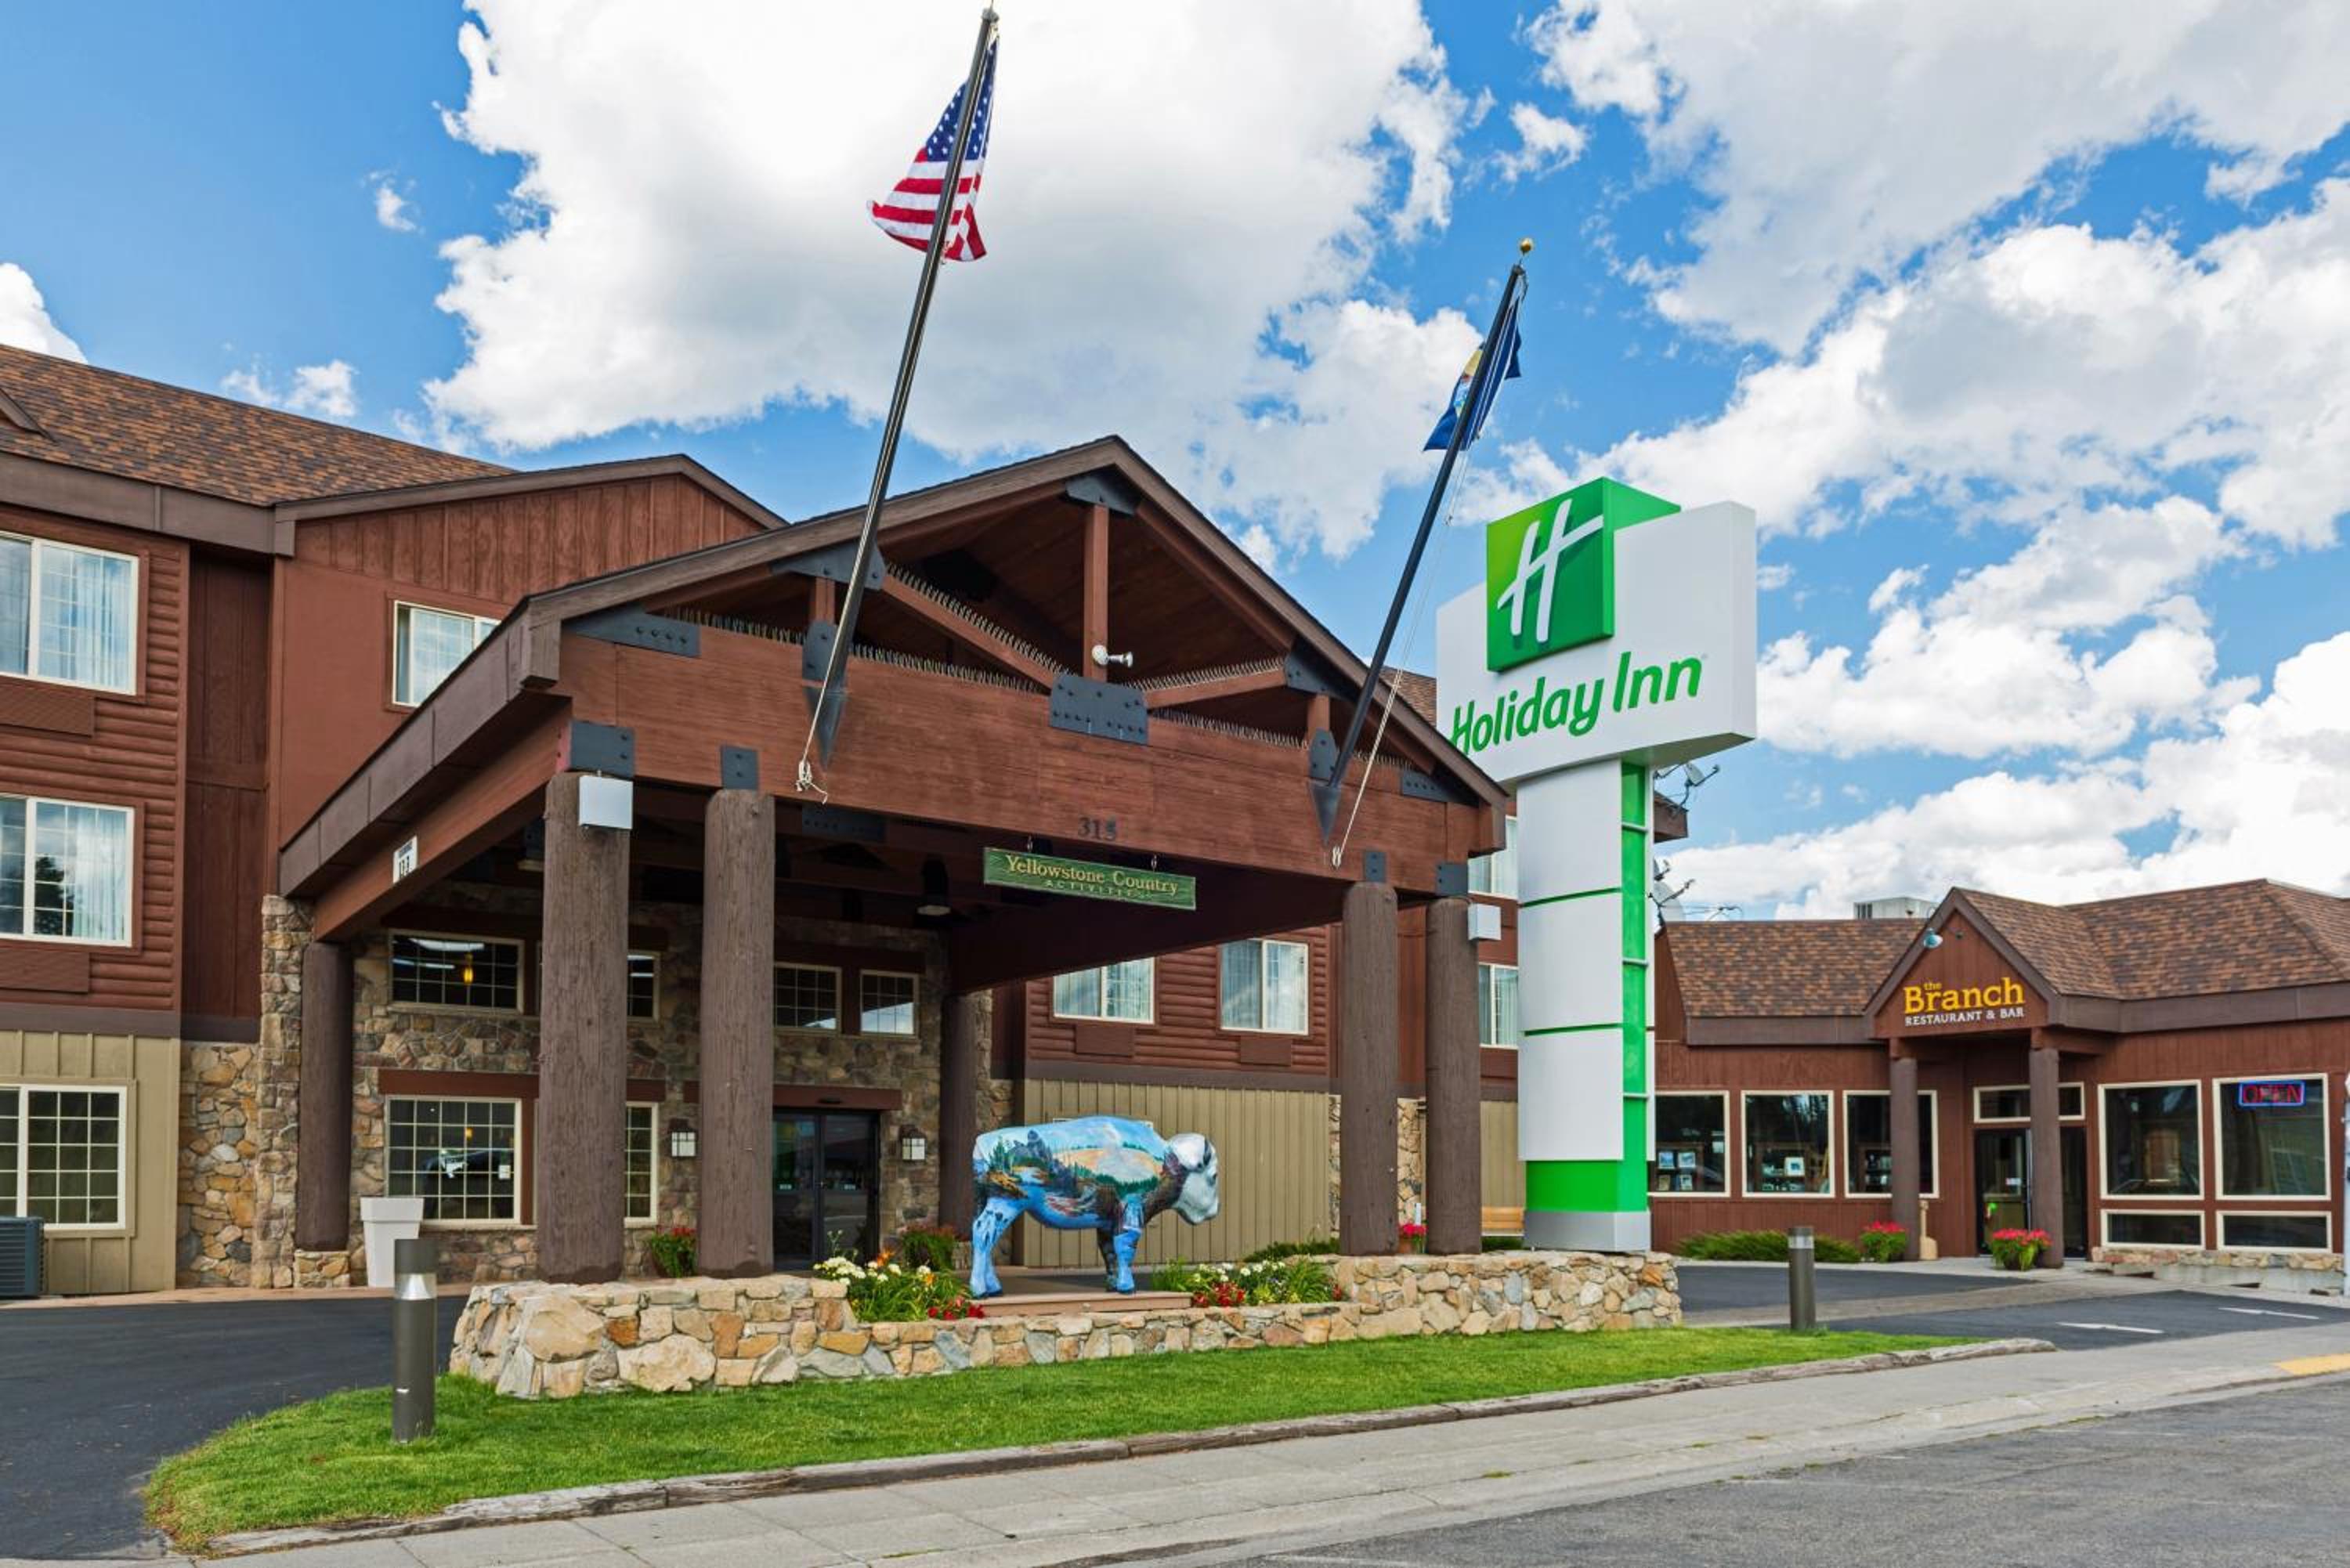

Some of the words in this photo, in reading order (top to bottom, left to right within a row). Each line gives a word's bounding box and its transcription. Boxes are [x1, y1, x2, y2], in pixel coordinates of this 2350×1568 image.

[1450, 676, 1604, 756] Holiday
[1612, 651, 1702, 713] Inn
[1005, 854, 1104, 883] Yellowstone
[1112, 870, 1178, 896] Country
[1904, 977, 2026, 1014] Branch
[1904, 1010, 1983, 1027] RESTAURANT
[1986, 1010, 1995, 1020] &
[2000, 1007, 2024, 1019] BAR
[2243, 1085, 2301, 1103] OPEN
